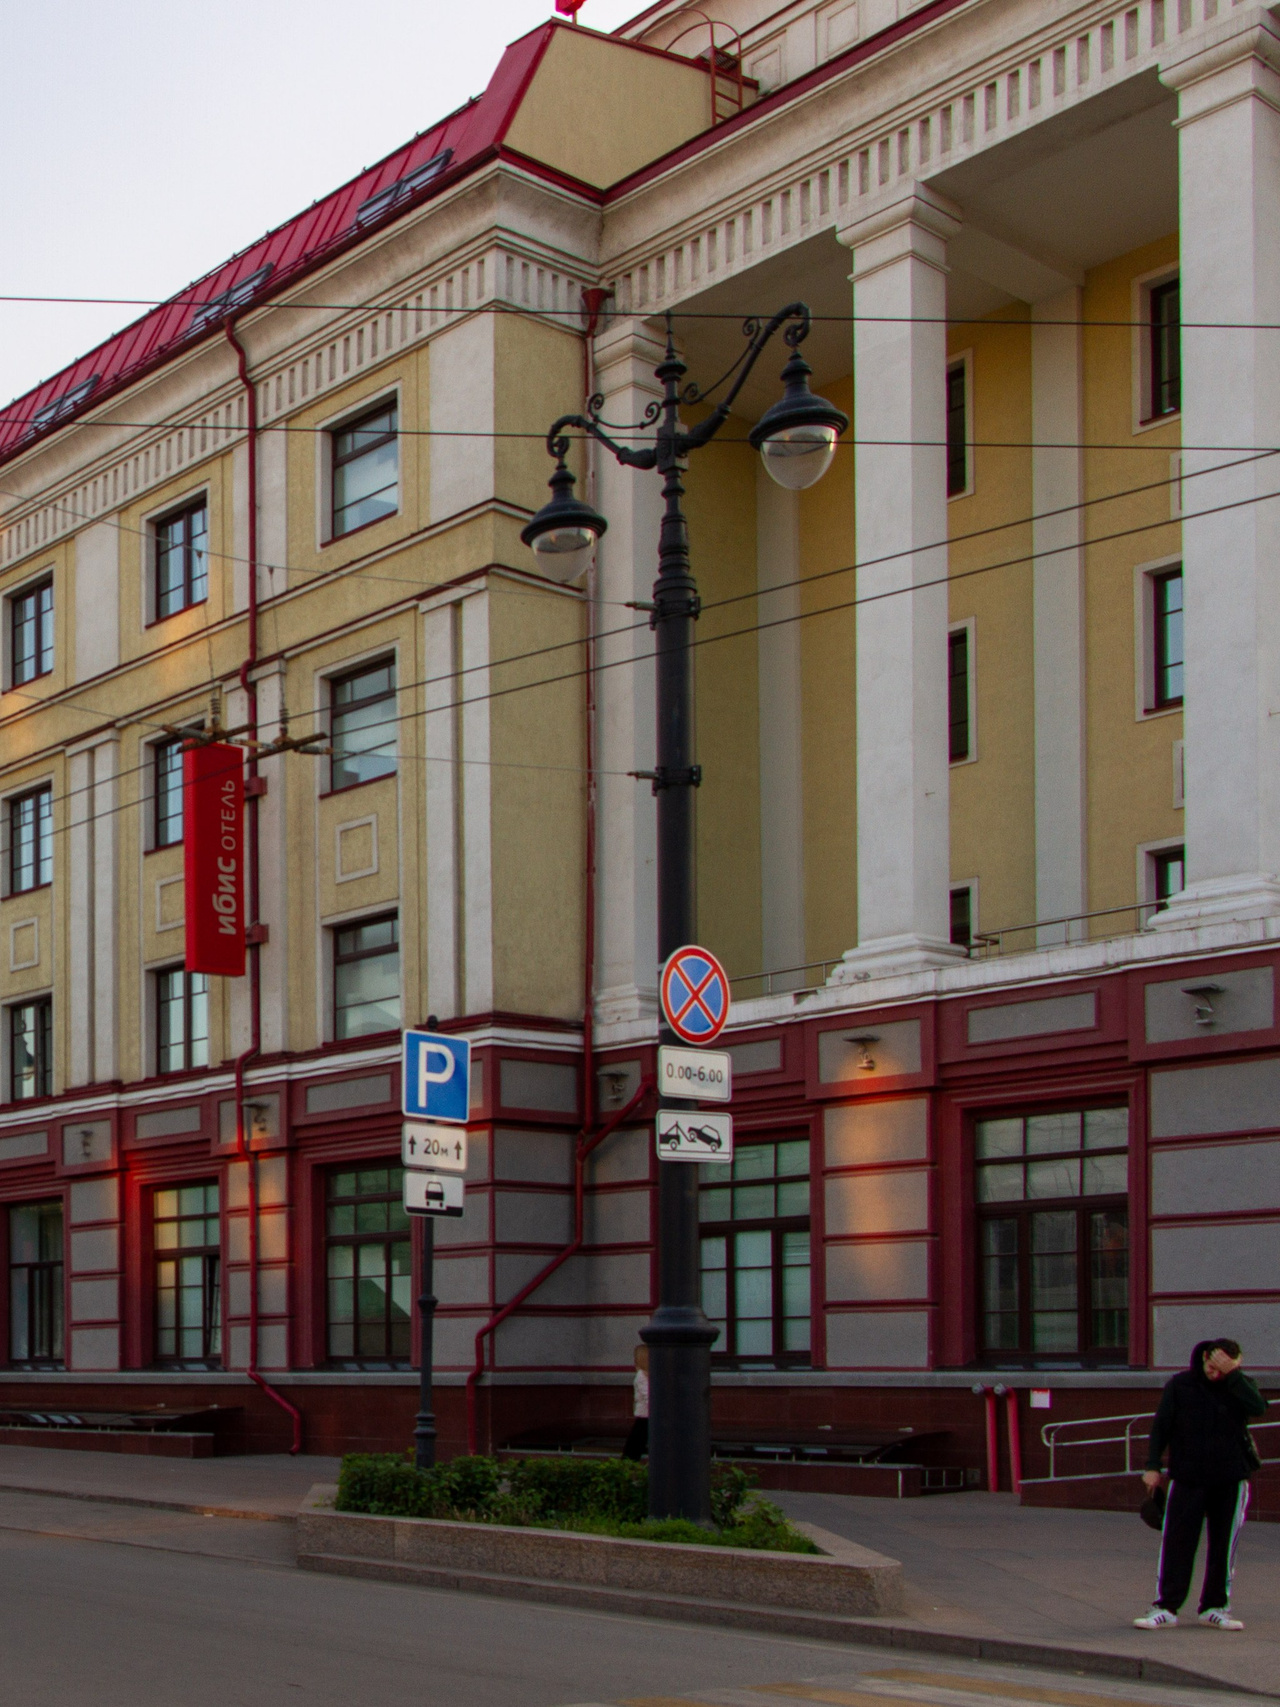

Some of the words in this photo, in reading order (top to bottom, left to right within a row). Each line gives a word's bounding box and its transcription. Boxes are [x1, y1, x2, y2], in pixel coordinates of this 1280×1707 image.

[221, 780, 236, 851] ОТЕЛЬ
[212, 856, 236, 935] ибис
[418, 1041, 455, 1108] P
[666, 1062, 723, 1083] 0.00-6.00
